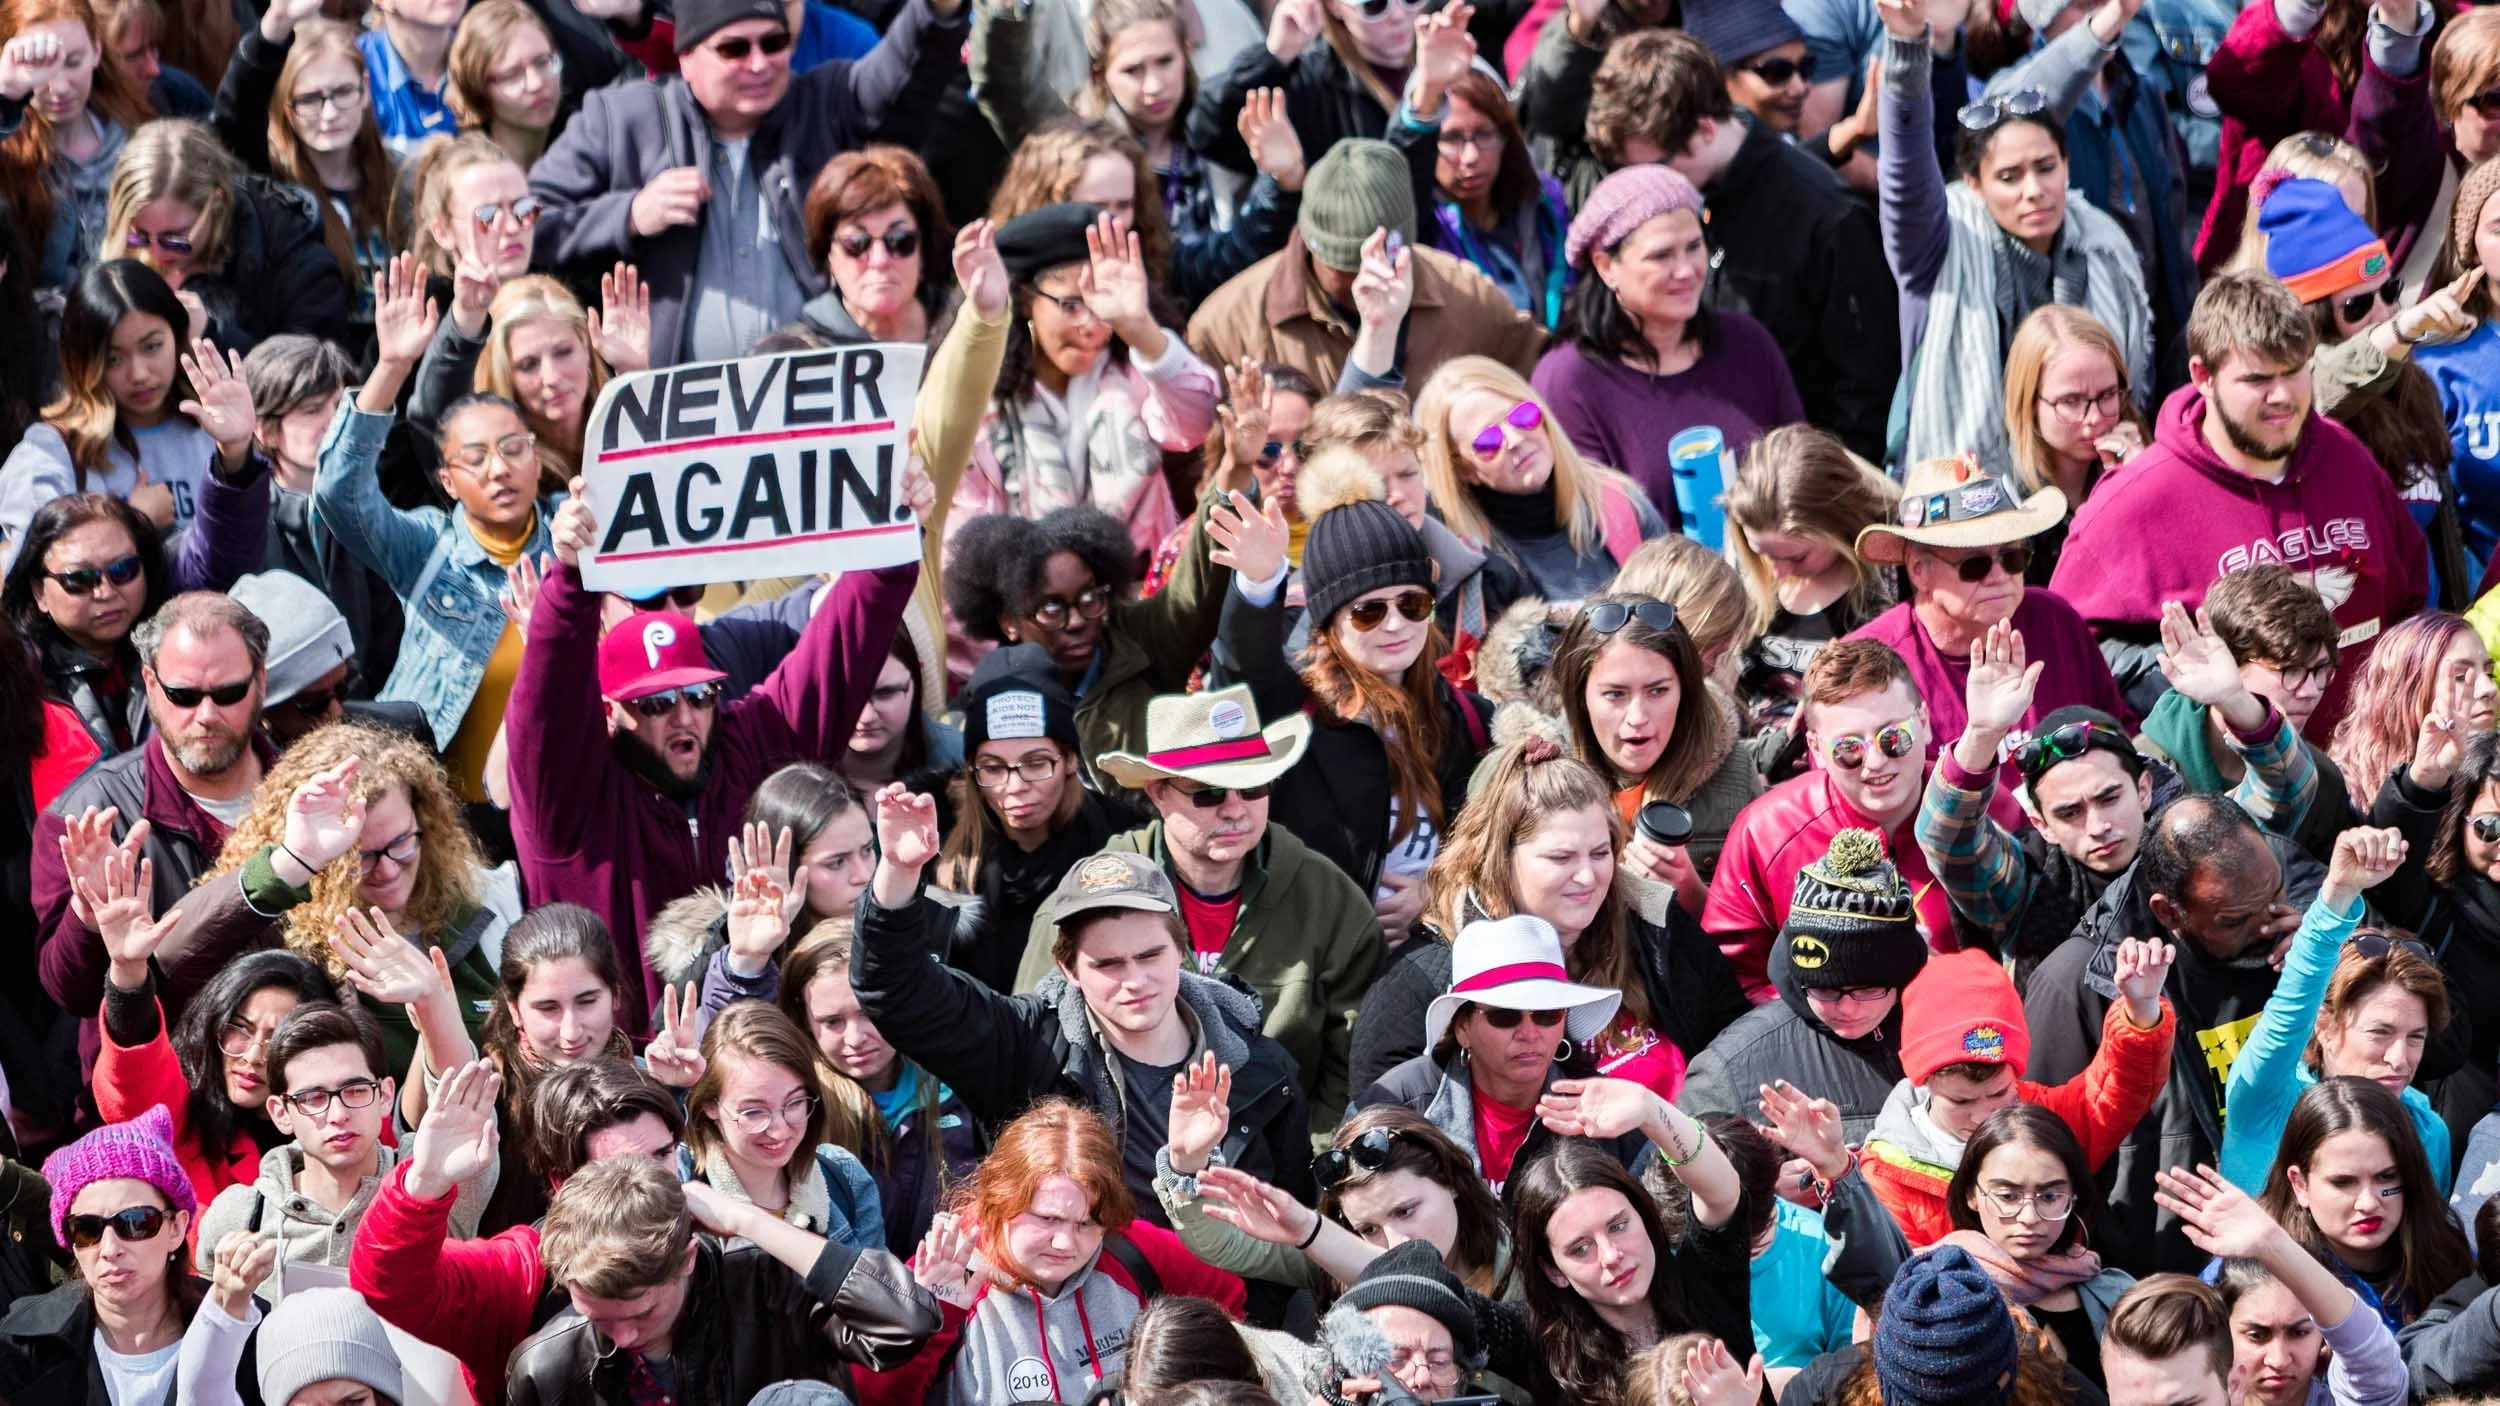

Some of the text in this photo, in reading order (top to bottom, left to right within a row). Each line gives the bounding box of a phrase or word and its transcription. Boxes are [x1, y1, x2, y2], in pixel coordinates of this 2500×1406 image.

[603, 348, 888, 452] NEVER
[599, 443, 912, 554] AGAIN.
[2218, 518, 2371, 576] EAGLES
[1075, 1328, 1126, 1360] MRIST
[1013, 1373, 1050, 1391] 2018
